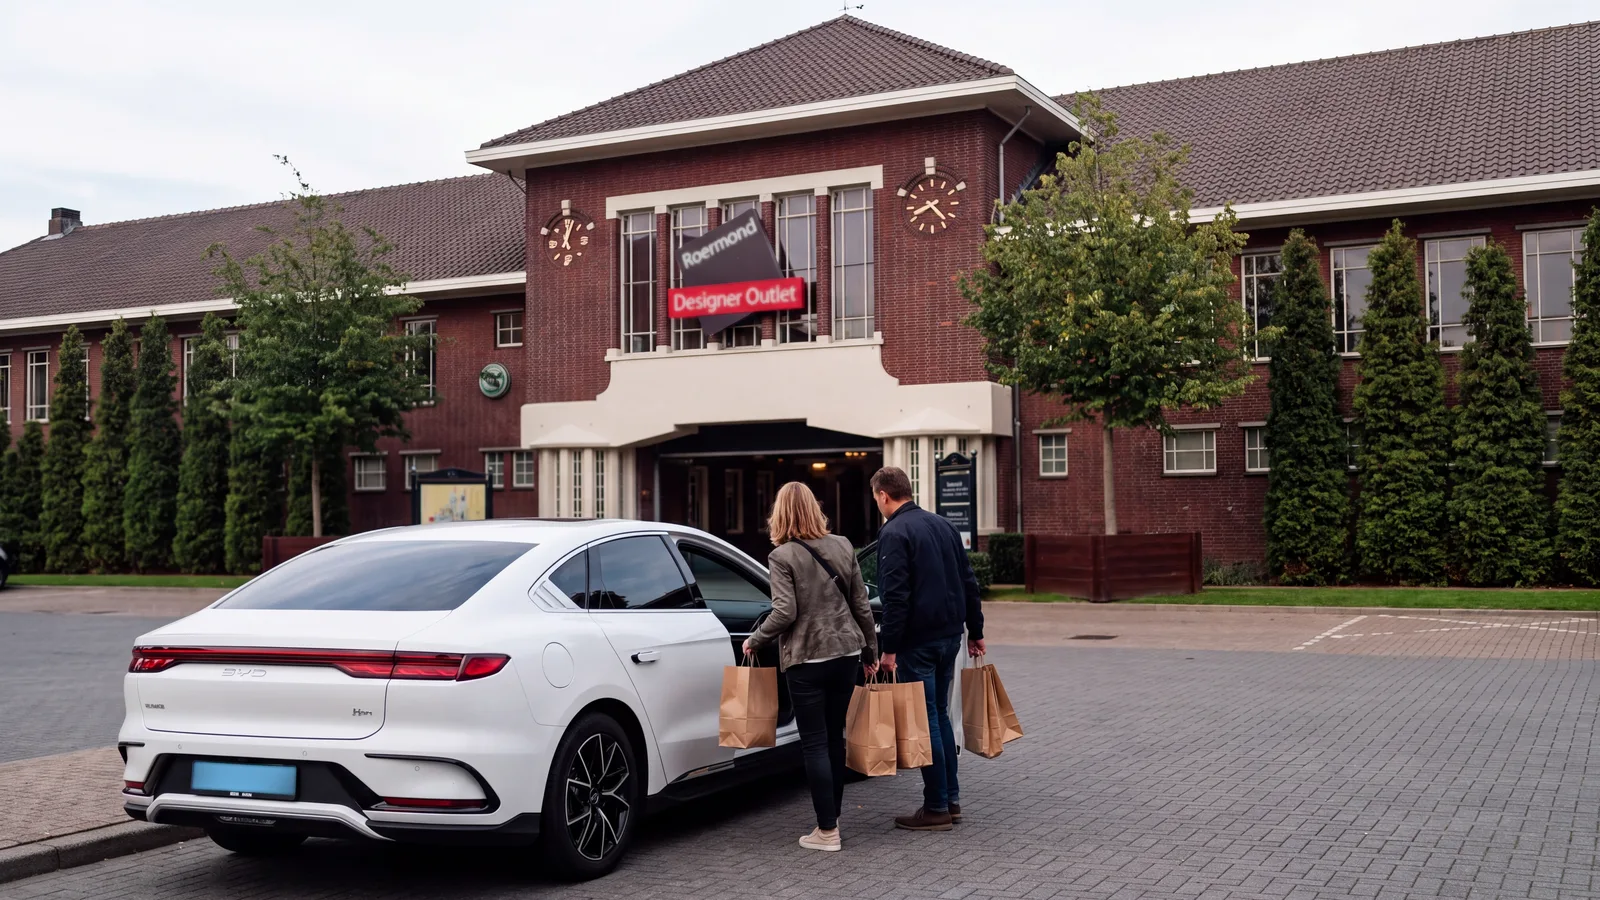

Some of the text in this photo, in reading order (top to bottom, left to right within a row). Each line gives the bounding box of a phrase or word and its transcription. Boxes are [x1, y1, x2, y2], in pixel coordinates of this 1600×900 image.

[681, 217, 757, 268] Roermond
[674, 285, 796, 313] Designer Outlet
[222, 668, 267, 678] BYD
